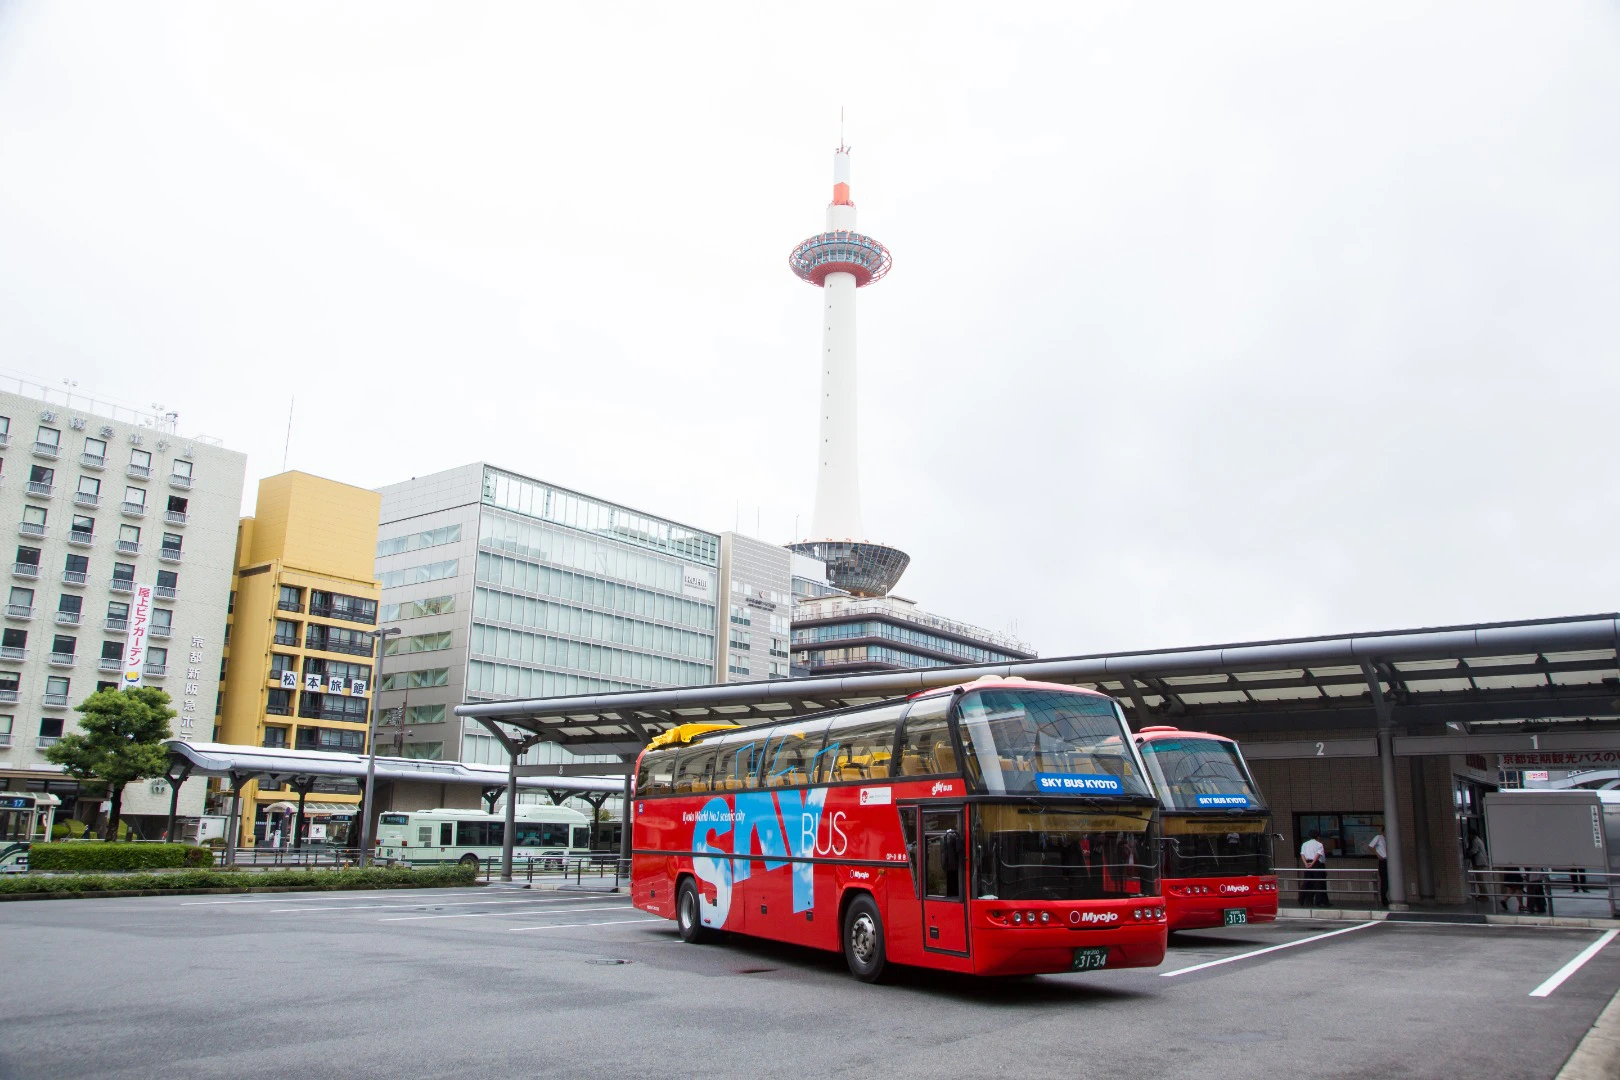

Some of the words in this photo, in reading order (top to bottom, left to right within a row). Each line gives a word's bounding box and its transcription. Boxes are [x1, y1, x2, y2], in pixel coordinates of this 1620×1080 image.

[128, 587, 151, 667] 屋上ビアガーデン
[283, 673, 365, 695] 松本旅館
[1316, 742, 1325, 756] 2
[1530, 735, 1538, 750] 1
[1041, 777, 1062, 788] SKY
[1064, 778, 1084, 789] BUS
[1085, 779, 1118, 790] KYOTO
[14, 799, 24, 807] 17
[801, 811, 848, 856] BUS
[1227, 884, 1249, 893] Myojo
[1082, 912, 1118, 923] Myojo
